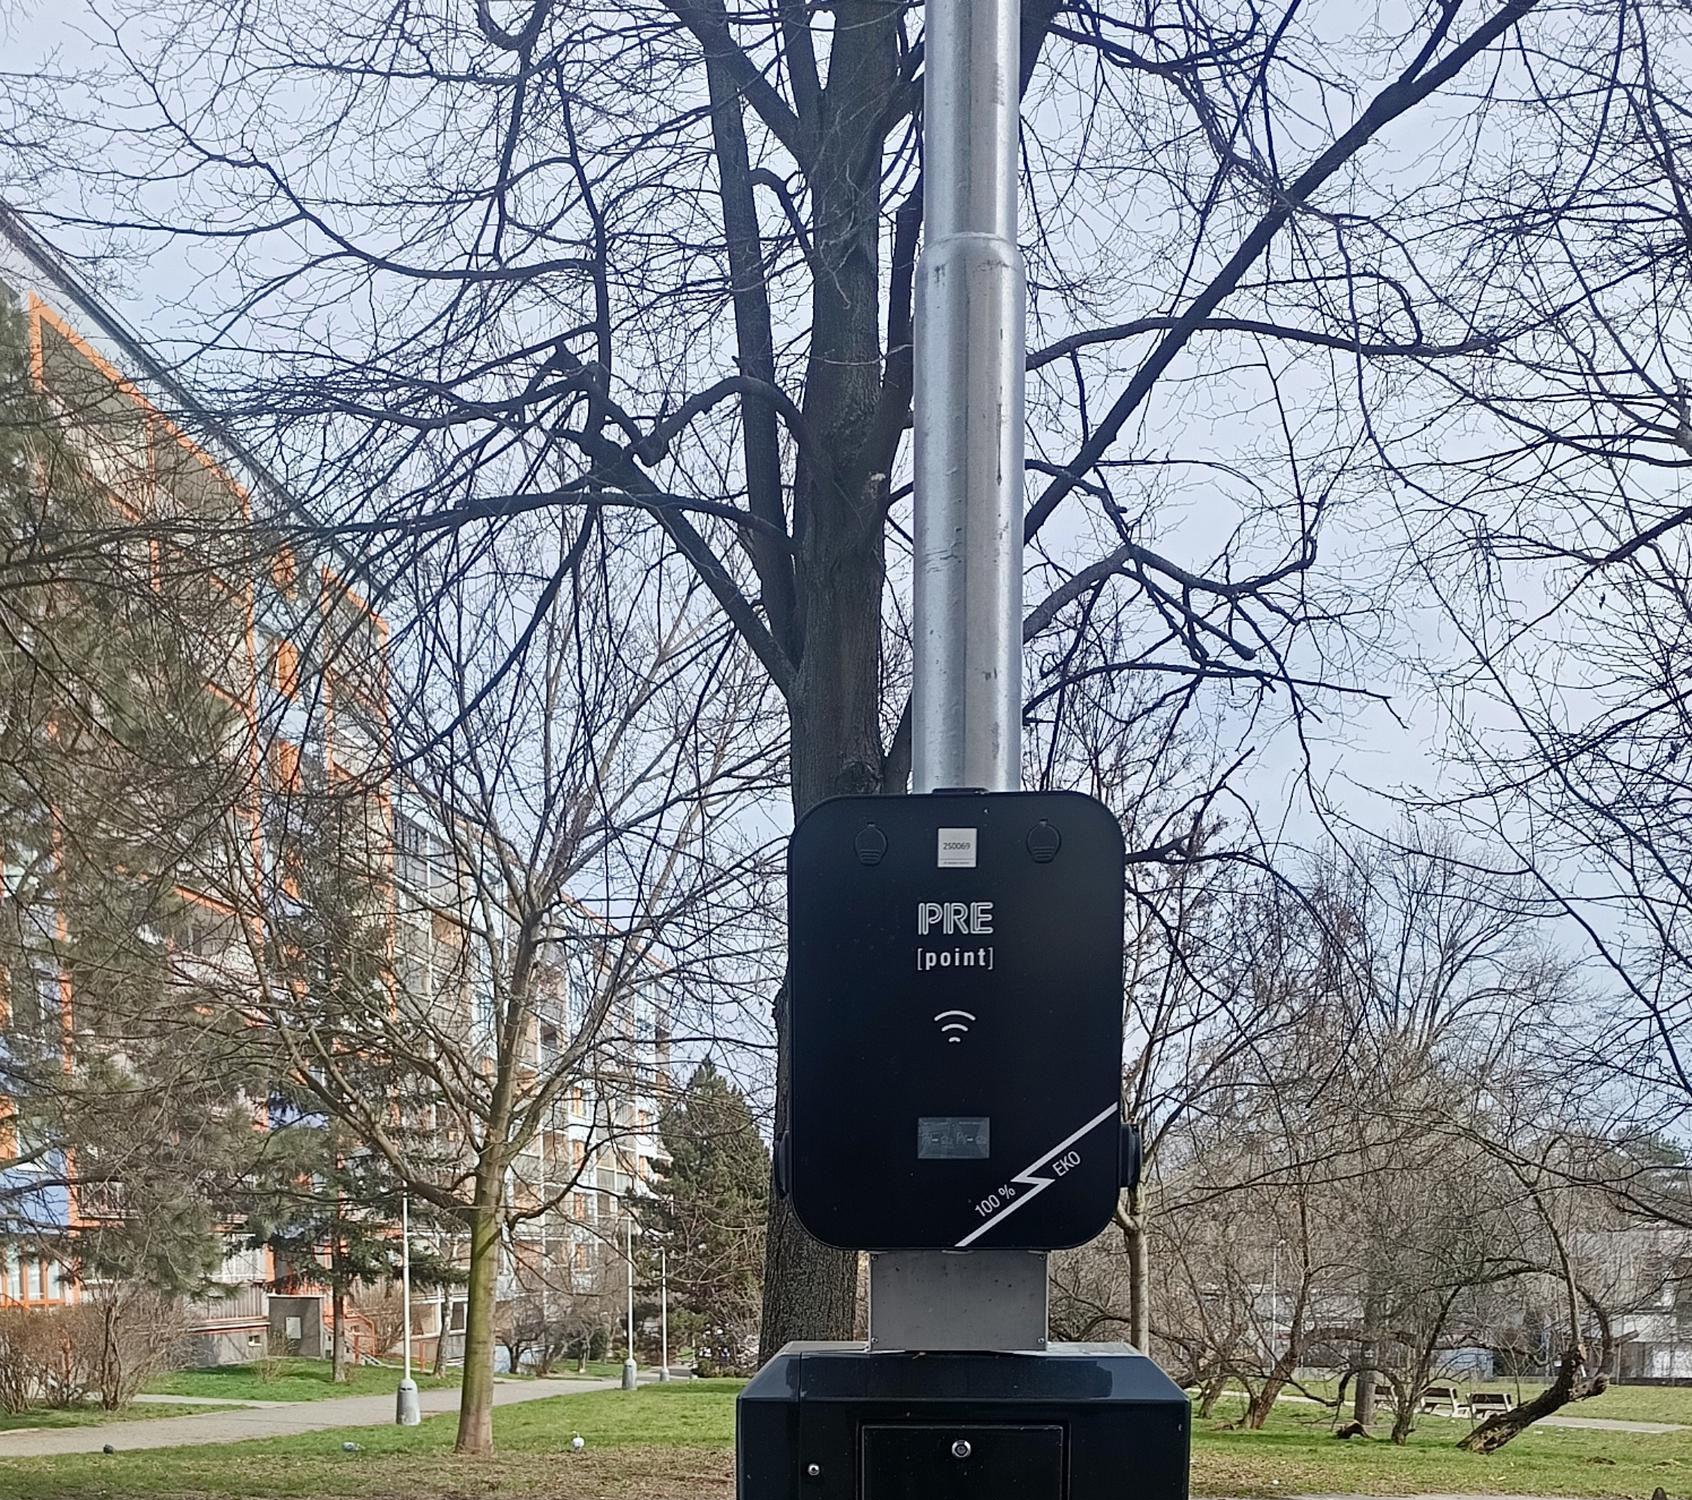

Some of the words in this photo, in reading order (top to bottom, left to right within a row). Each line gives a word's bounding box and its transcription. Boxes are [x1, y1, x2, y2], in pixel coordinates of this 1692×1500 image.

[918, 902, 993, 935] PRE
[917, 947, 993, 971] [point]
[974, 1194, 1001, 1217] 100
[998, 1184, 1016, 1200] %
[1052, 1150, 1081, 1177] EKO
